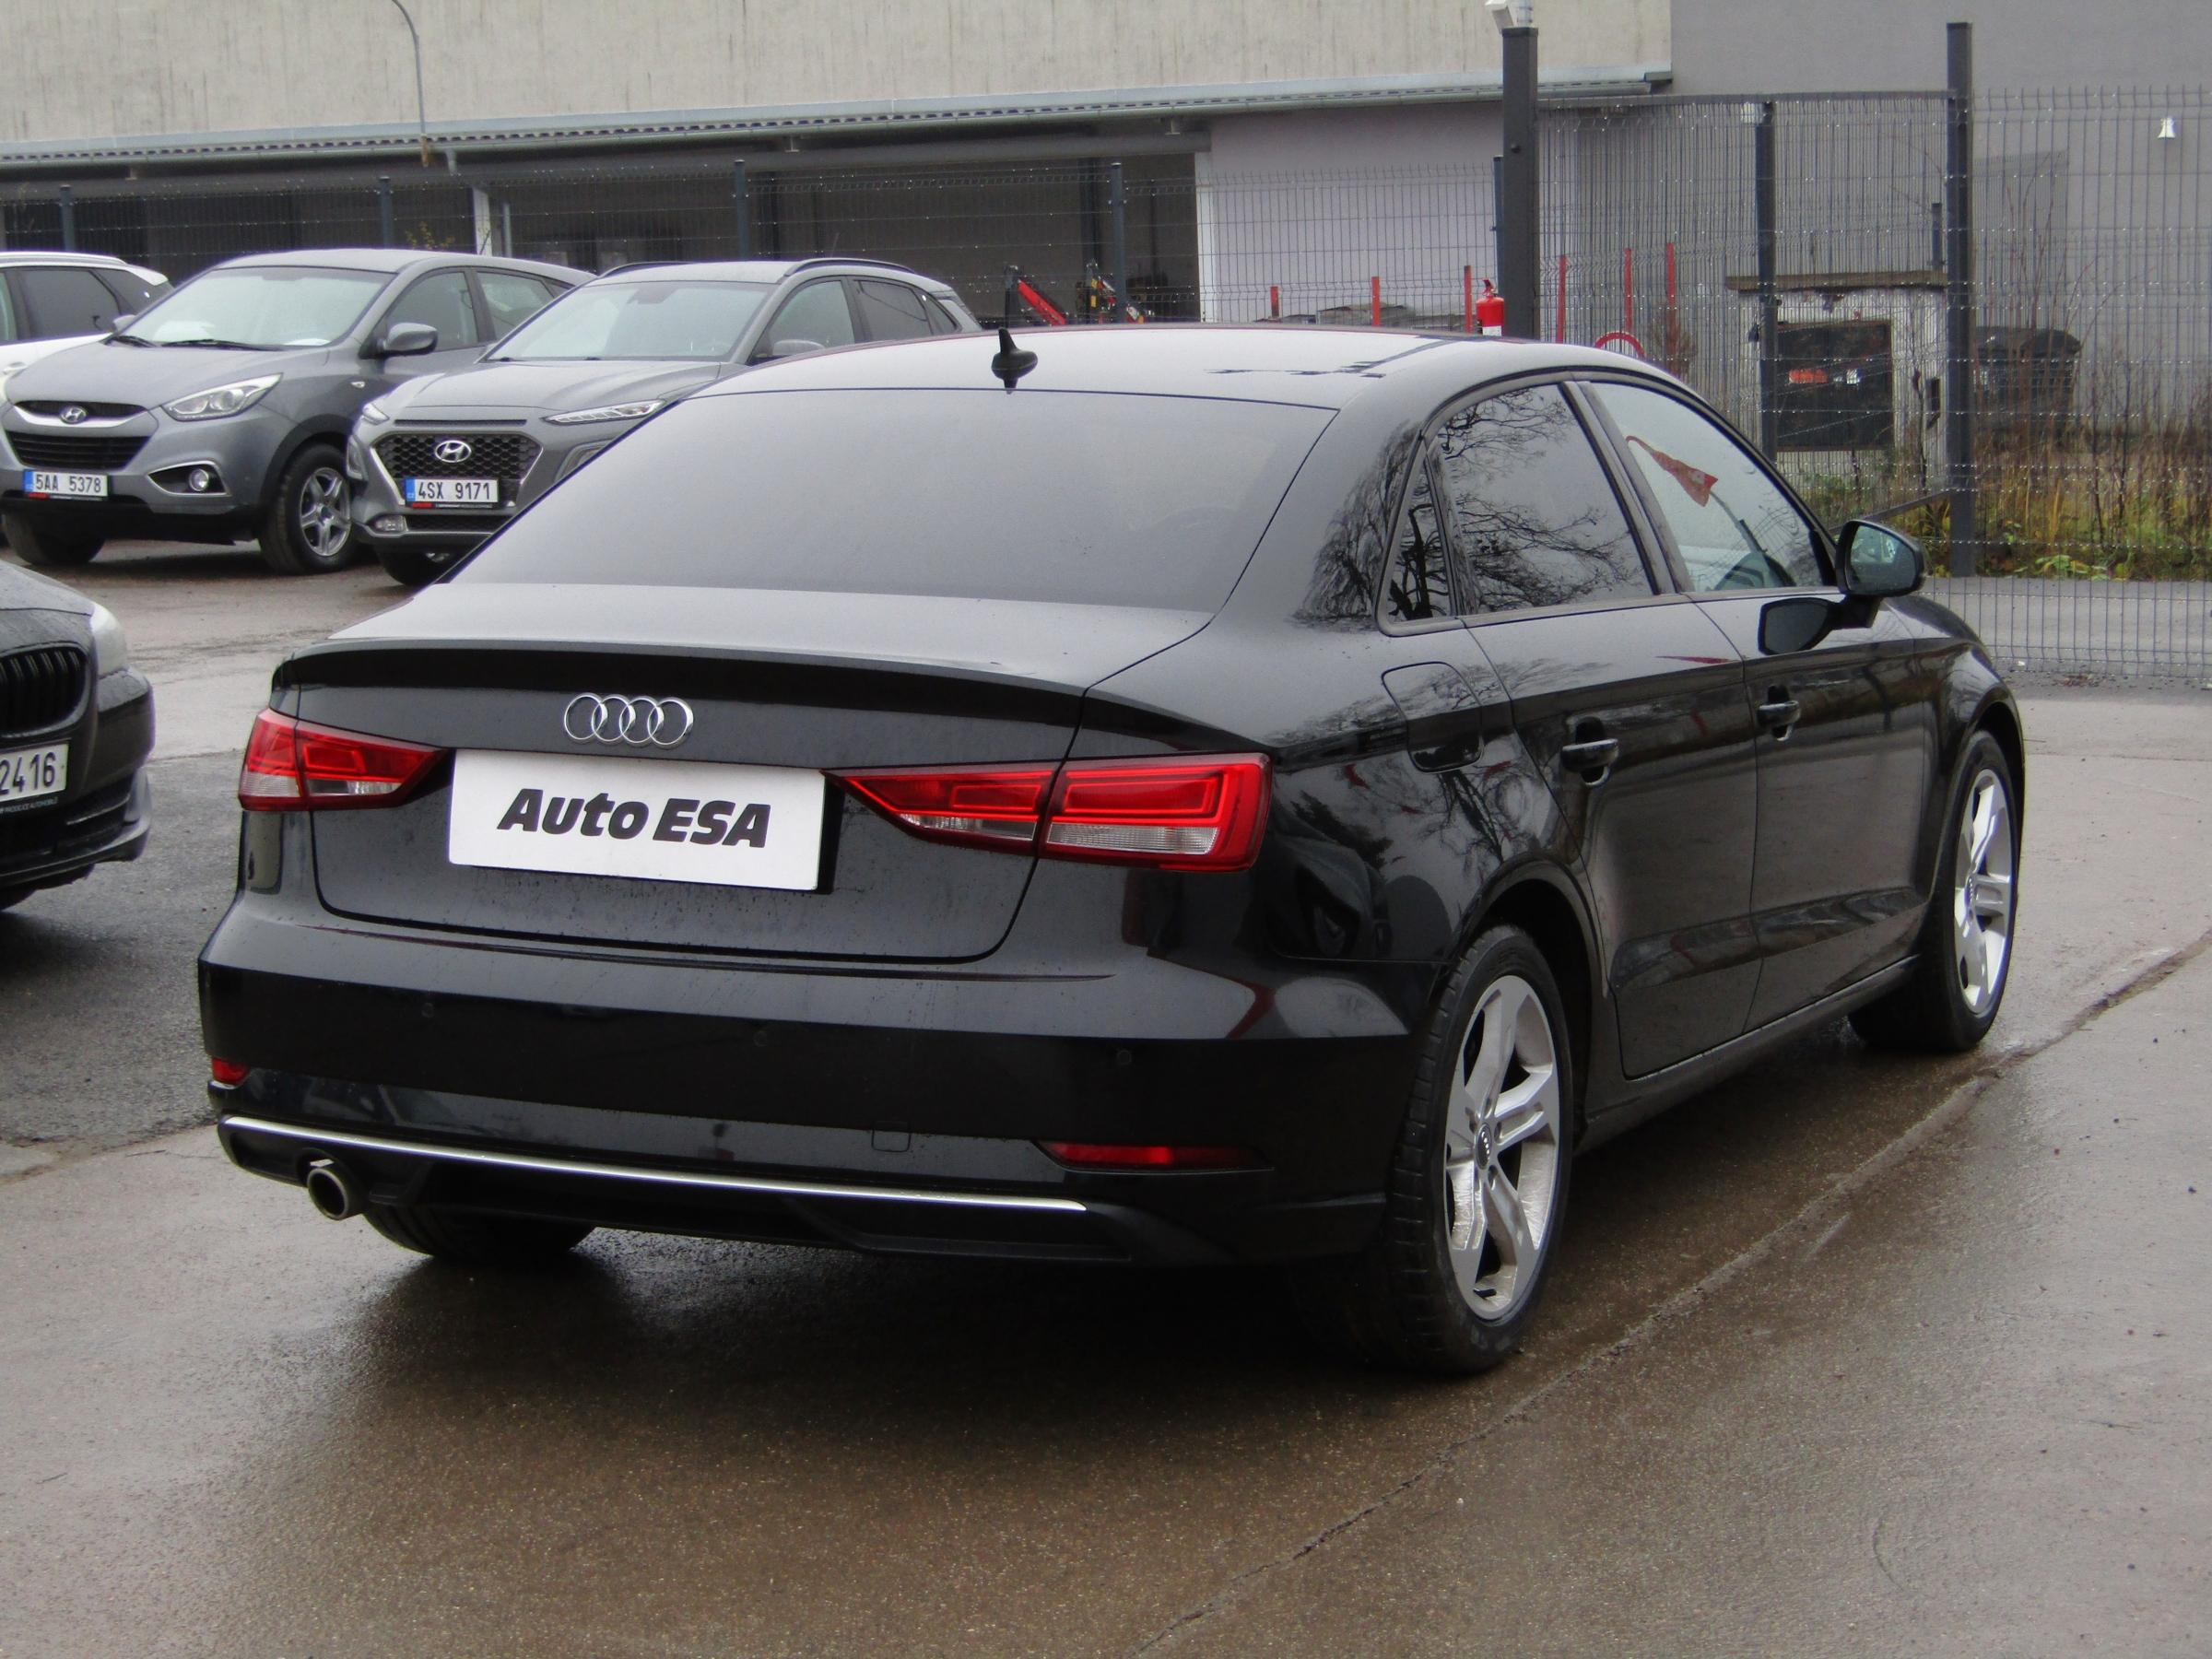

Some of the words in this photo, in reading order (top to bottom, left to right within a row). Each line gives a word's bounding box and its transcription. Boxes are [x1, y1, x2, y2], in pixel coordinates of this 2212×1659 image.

[36, 474, 58, 490] 5AA
[69, 476, 101, 493] 5378
[418, 482, 444, 499] 4SX
[455, 482, 490, 500] 9171
[0, 751, 56, 794] 2416
[497, 788, 650, 840] Auto
[653, 797, 771, 848] ESA
